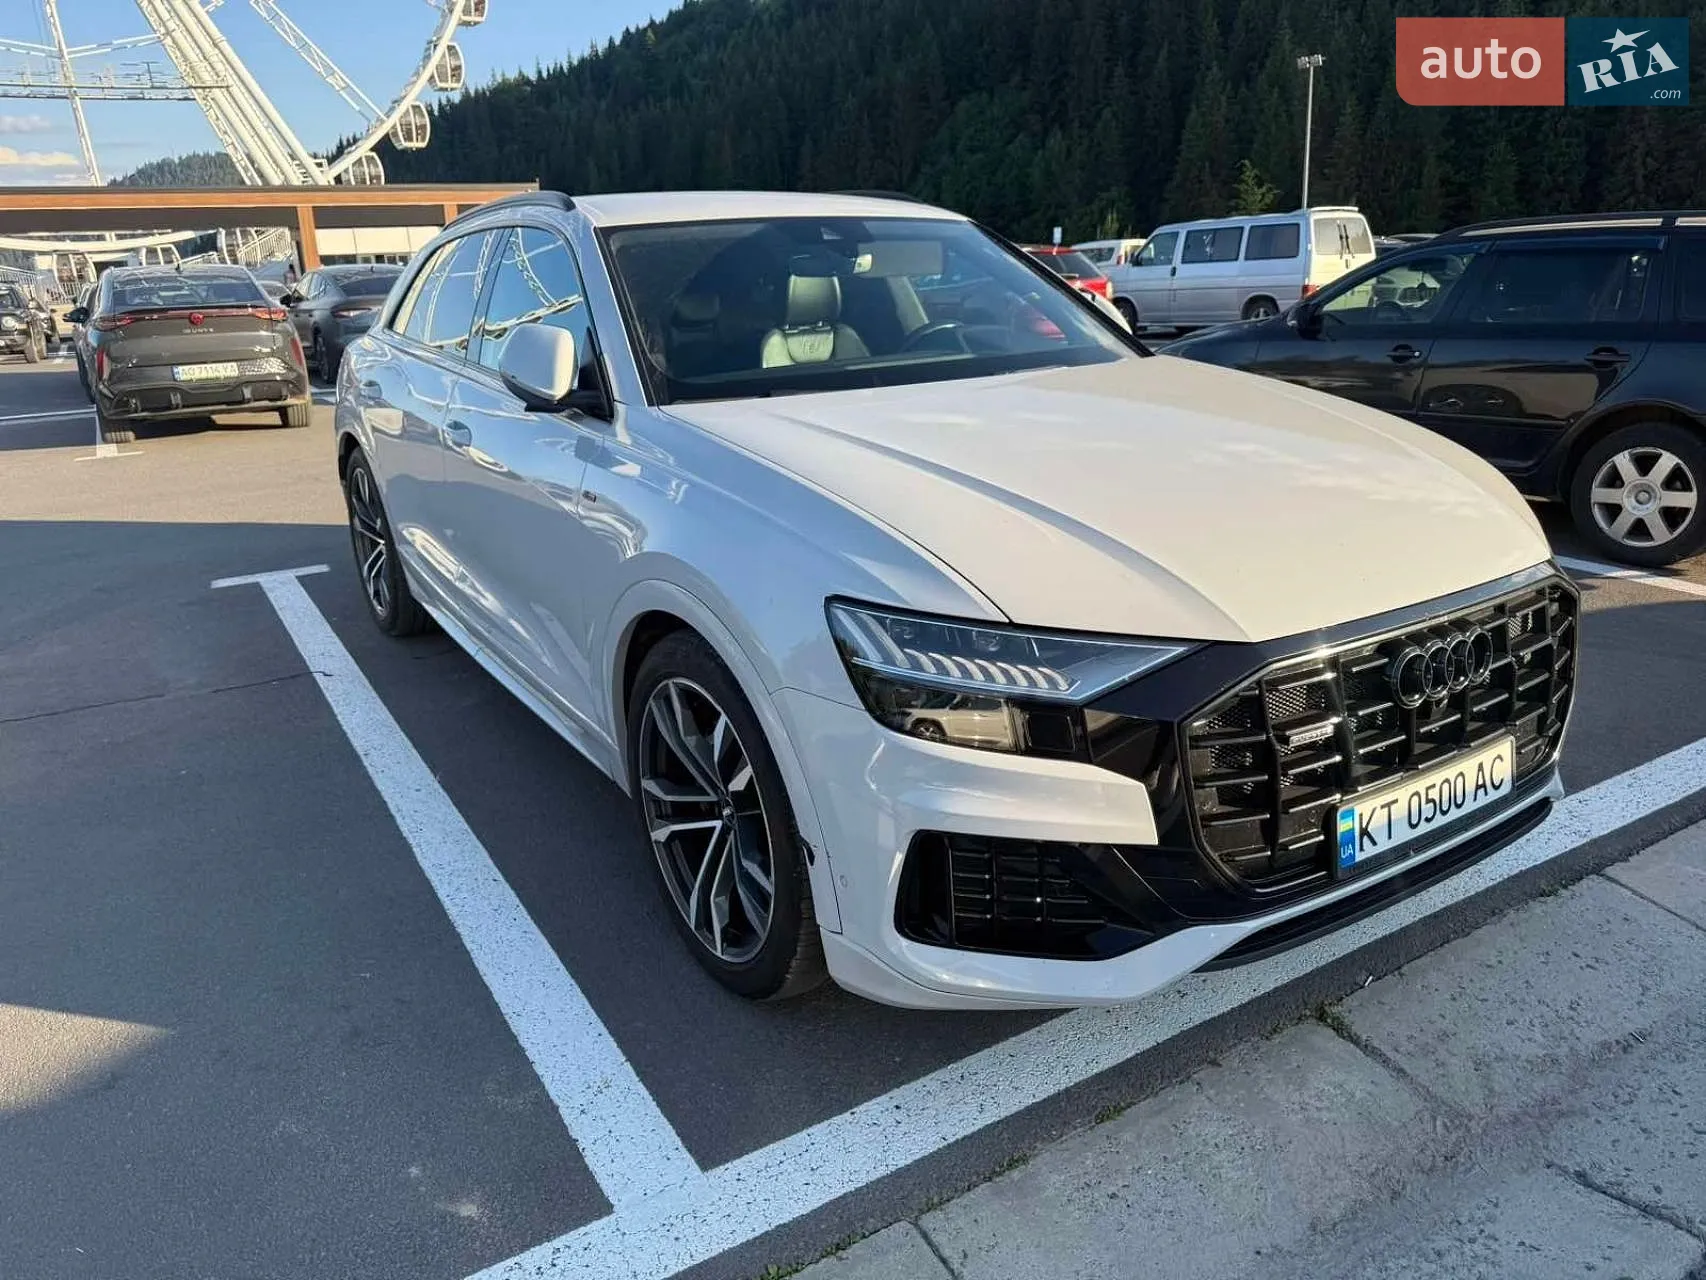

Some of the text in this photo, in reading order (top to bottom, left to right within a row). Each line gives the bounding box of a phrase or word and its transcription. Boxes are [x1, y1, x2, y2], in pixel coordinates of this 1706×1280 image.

[1358, 753, 1505, 852] KT 0500 AC
[1340, 844, 1354, 859] UA
